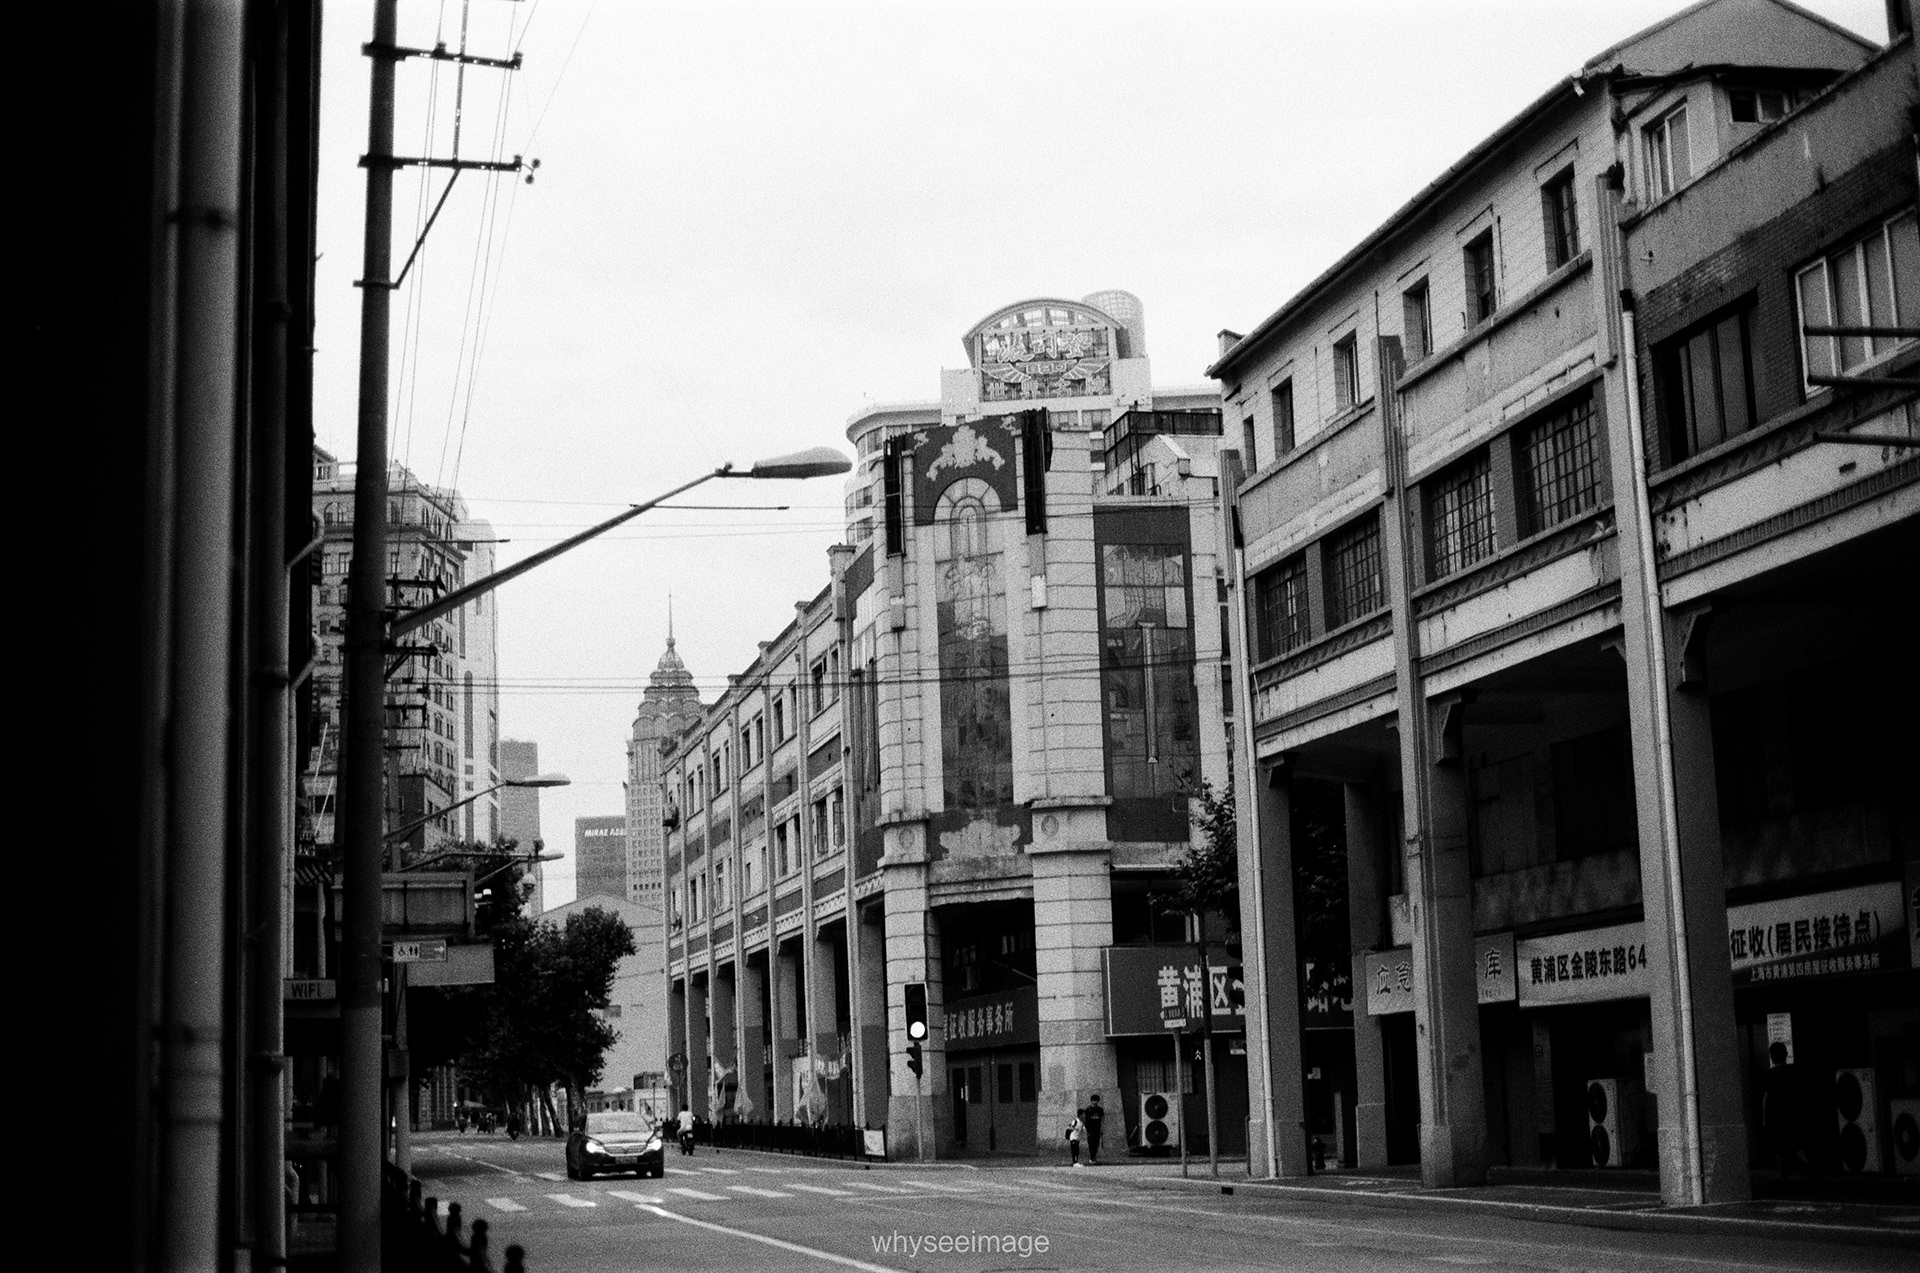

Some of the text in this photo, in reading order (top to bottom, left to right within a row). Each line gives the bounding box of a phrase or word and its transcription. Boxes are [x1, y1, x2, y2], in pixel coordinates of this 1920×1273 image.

[1530, 944, 1648, 986] 黄浦区金陵东路64
[1731, 910, 1881, 960] 征收(居民接待点)
